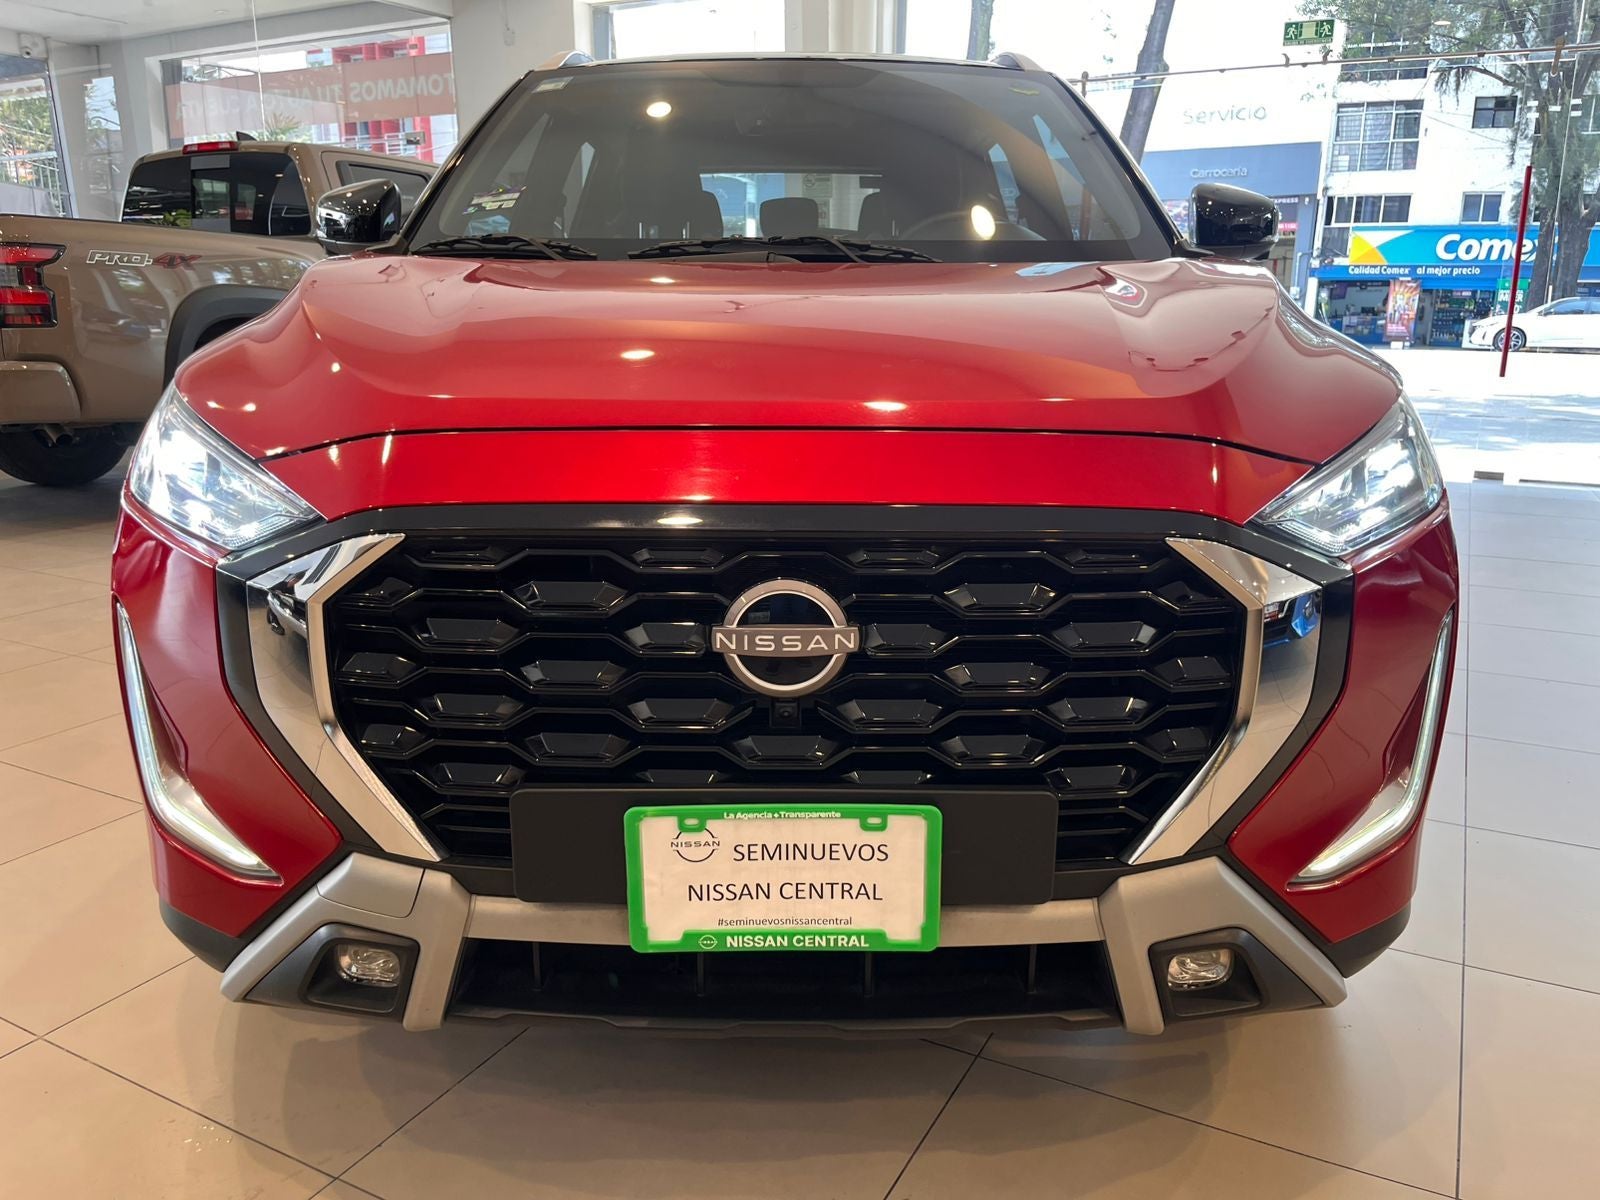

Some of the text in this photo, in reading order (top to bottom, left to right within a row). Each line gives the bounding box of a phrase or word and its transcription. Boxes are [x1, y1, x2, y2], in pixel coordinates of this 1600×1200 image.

[1183, 105, 1268, 125] Servicio
[1348, 265, 1481, 277] Calidad Comex al mejor precio
[715, 632, 855, 651] NISSAN
[723, 811, 735, 819] La
[736, 811, 773, 820] Agencia
[671, 840, 720, 848] NISSAN
[733, 843, 889, 862] SEMINUEVOS
[688, 882, 883, 902] NISSAN CENTRAL
[717, 916, 852, 927] #seminuevosnissancentral
[726, 935, 869, 948] NISSAN CENTRAL
